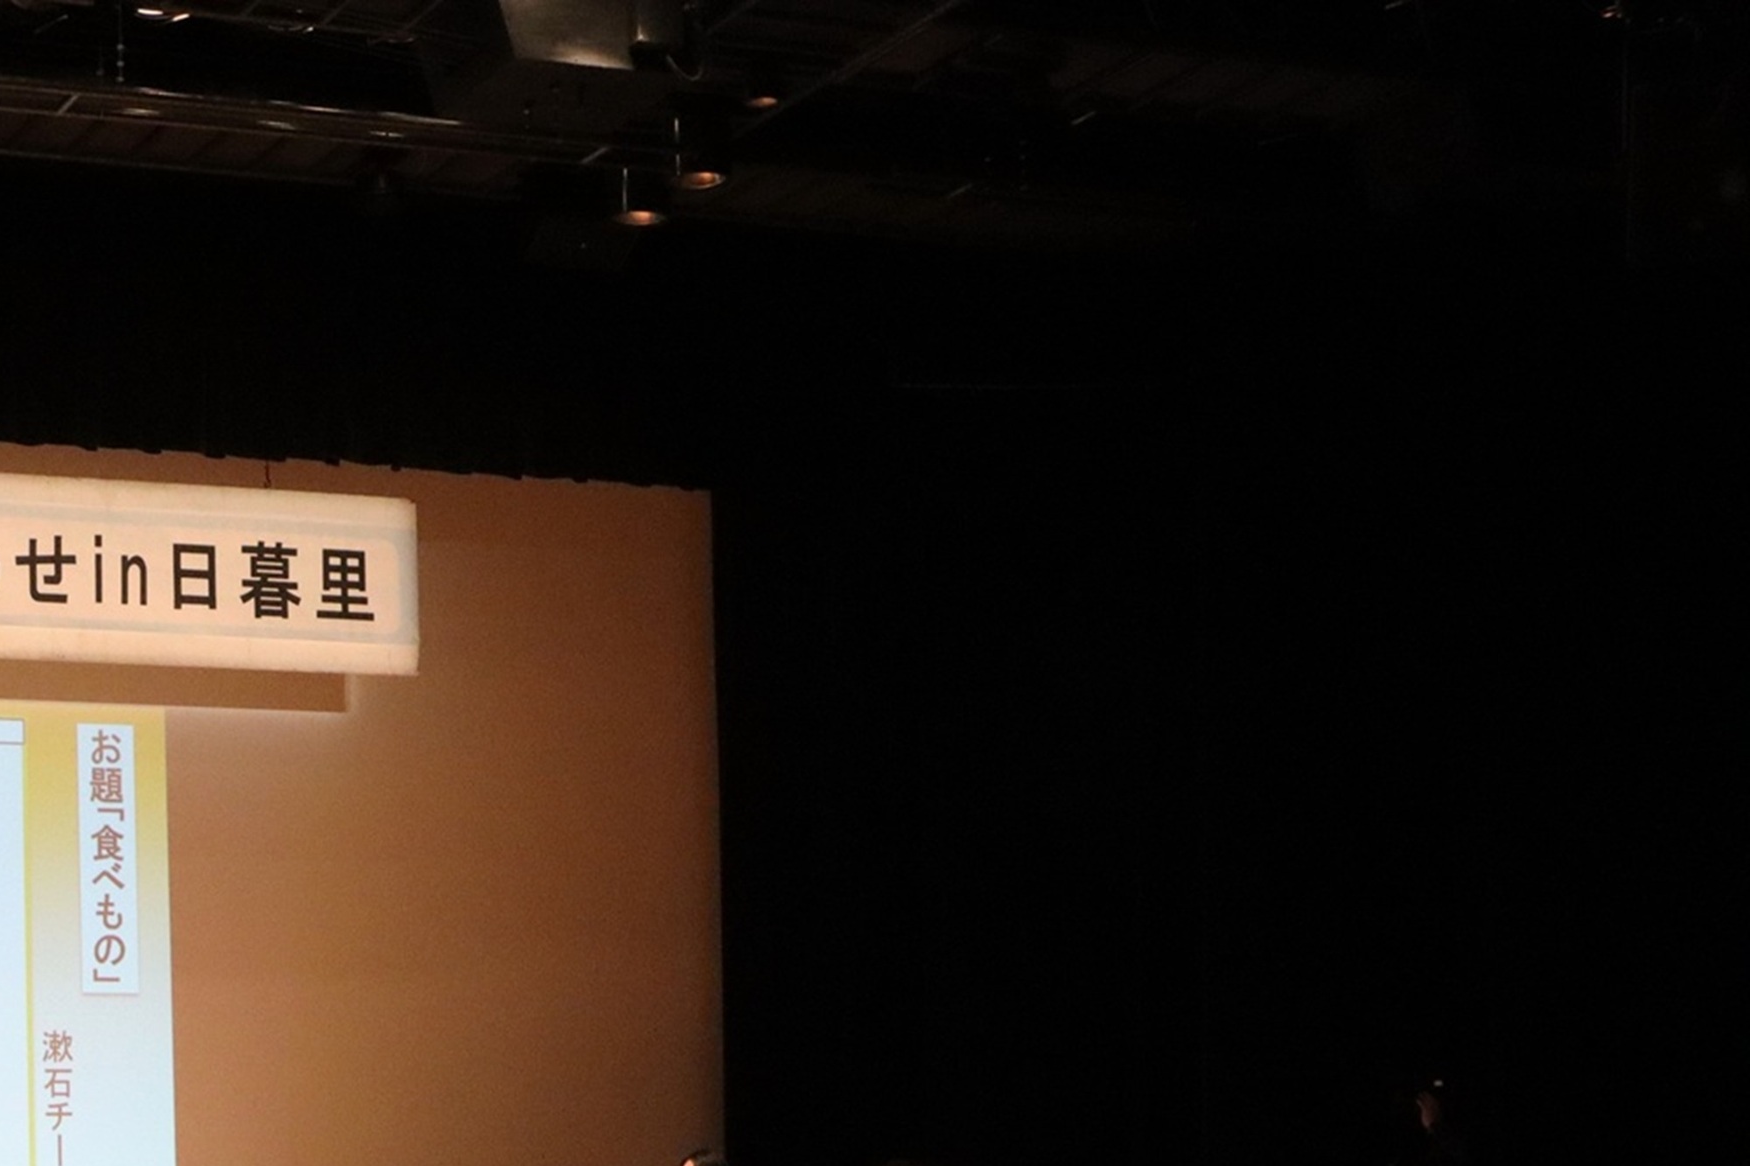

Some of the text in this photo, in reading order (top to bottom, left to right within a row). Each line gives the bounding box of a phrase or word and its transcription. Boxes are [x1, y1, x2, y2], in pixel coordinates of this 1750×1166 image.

[90, 729, 126, 982] お題「食べもの」
